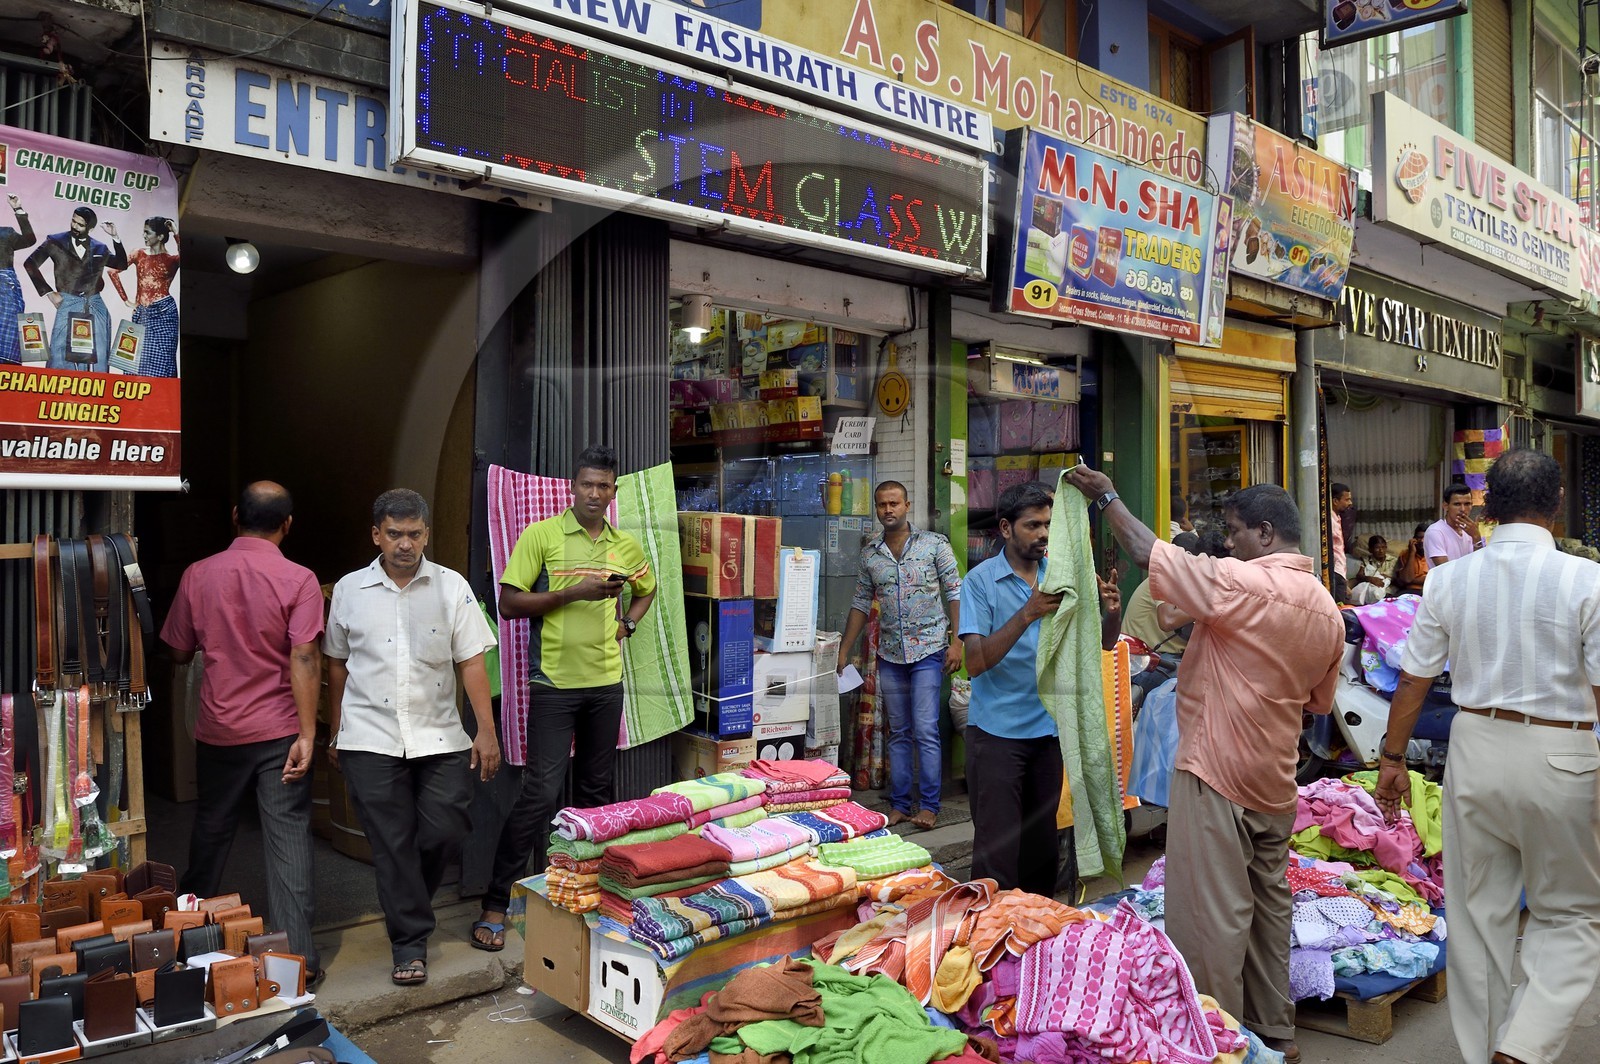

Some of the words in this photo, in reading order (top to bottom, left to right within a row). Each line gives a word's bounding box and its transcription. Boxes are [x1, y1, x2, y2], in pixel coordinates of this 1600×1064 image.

[674, 12, 858, 102] FASHRATH
[874, 81, 980, 141] CENTRE
[1100, 84, 1138, 112] ESTB
[1143, 102, 1174, 126] 1874
[15, 148, 118, 184] CHAMPION
[122, 170, 160, 192] CUP
[1261, 144, 1356, 221] ASIAN
[53, 181, 132, 210] LUNGIES
[632, 129, 775, 212] STEM
[795, 172, 923, 244] GLASS
[1434, 134, 1507, 211] FIVE
[1513, 181, 1579, 249] STAR
[1137, 178, 1201, 236] SHA
[1431, 205, 1441, 220] 95
[1291, 205, 1353, 244] ELECTRONICS
[1444, 193, 1518, 248] TEXTILES
[1522, 231, 1570, 272] CENTRE
[1124, 227, 1202, 275] TRADERS
[1452, 228, 1465, 242] 2ND
[1465, 233, 1485, 251] CROSS
[1031, 285, 1052, 302] 91
[1065, 285, 1081, 297] Dealers
[1081, 287, 1086, 297] in
[1382, 297, 1427, 351] STAR
[1429, 312, 1501, 369] TEXTILES
[1416, 354, 1428, 373] 95
[0, 371, 106, 398] CHAMPION
[112, 380, 152, 400] CUP
[38, 401, 121, 424] LUNGIES
[844, 420, 868, 428] CREDIT
[1, 436, 100, 461] vailable
[110, 440, 165, 463] Here
[835, 442, 868, 450] ACCEPTED
[844, 431, 862, 439] CARD
[766, 725, 793, 734] Richsonic
